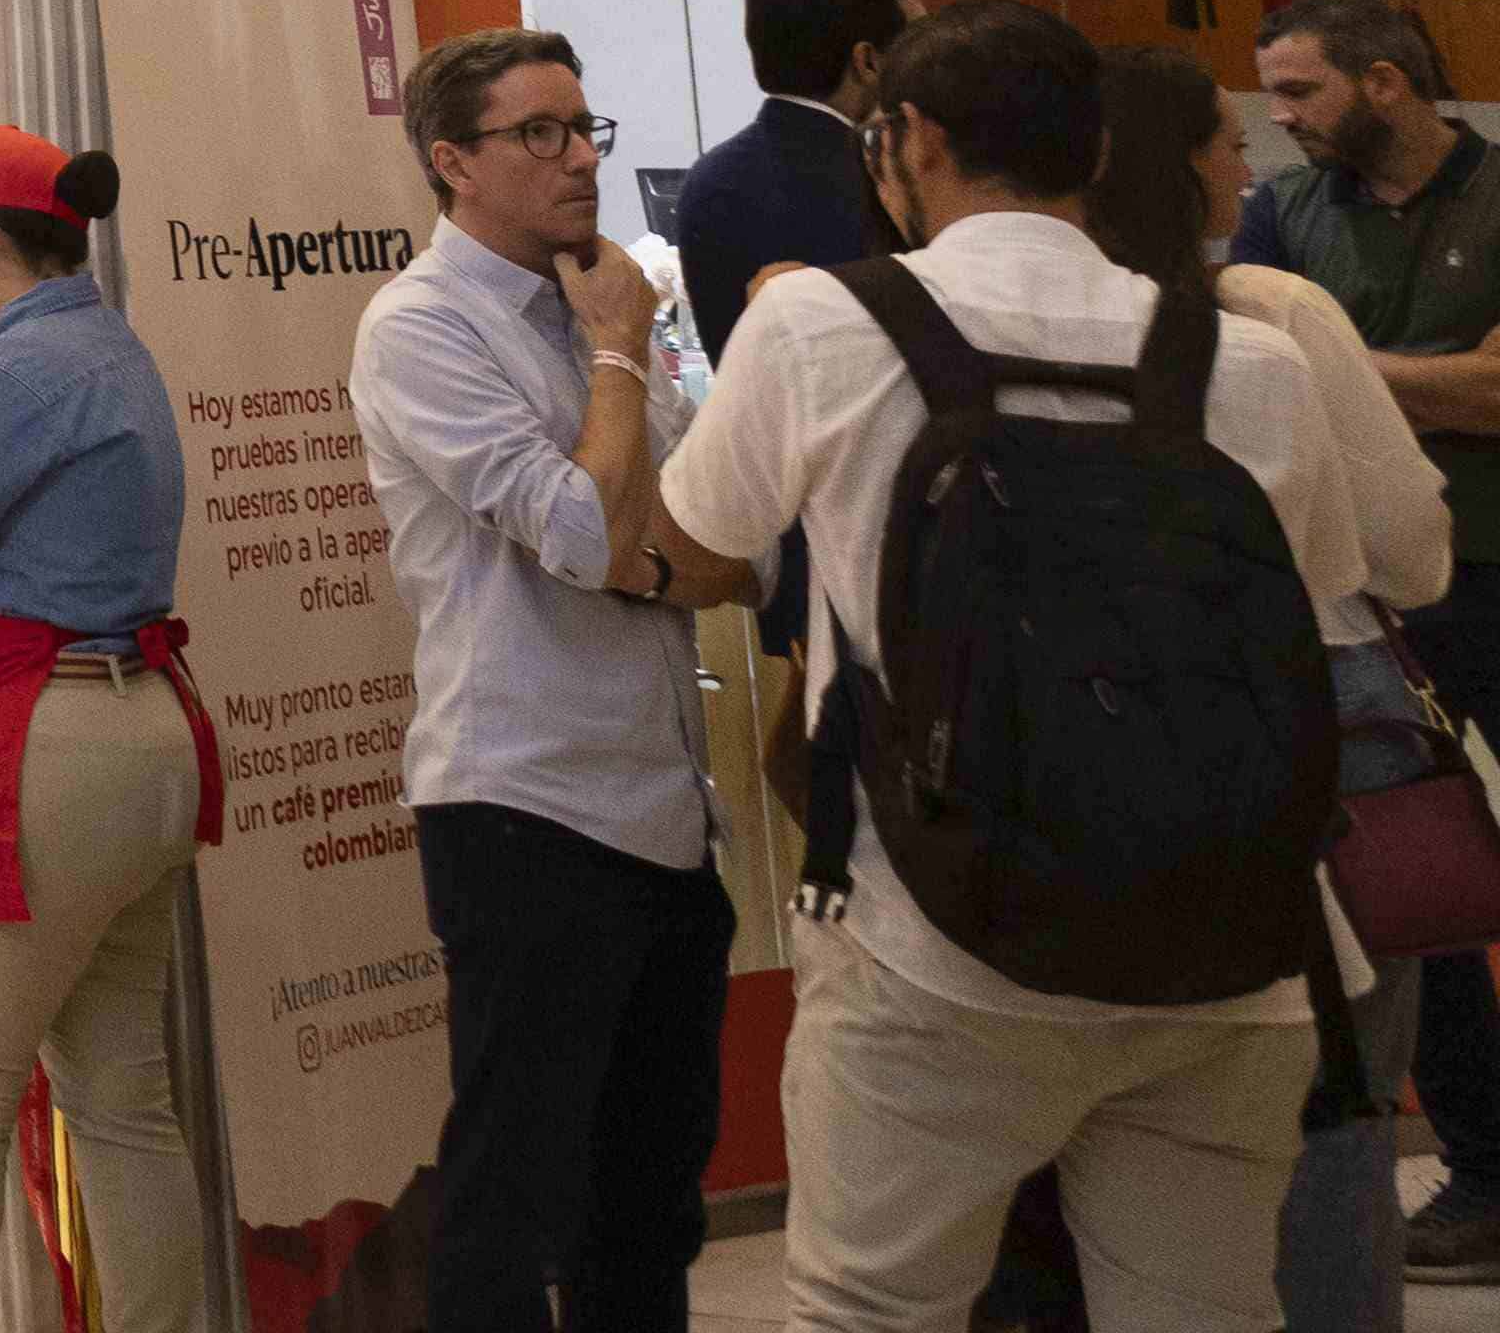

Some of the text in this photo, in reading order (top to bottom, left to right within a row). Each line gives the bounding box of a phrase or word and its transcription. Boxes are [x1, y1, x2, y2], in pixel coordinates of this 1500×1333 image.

[166, 217, 415, 291] Pre-Apertura
[188, 391, 235, 430] Hoy
[241, 387, 332, 419] estamos
[211, 434, 299, 481] pruebas
[206, 486, 299, 524] nuestras
[226, 533, 293, 581] previo
[298, 536, 312, 563] a
[317, 527, 339, 561] la
[300, 572, 376, 613] oficial.
[225, 693, 274, 732] Muy
[280, 682, 354, 728] pronto
[226, 744, 286, 782] listos
[290, 734, 340, 777] para
[233, 801, 267, 833] un
[272, 784, 316, 826] café
[343, 968, 356, 997] a
